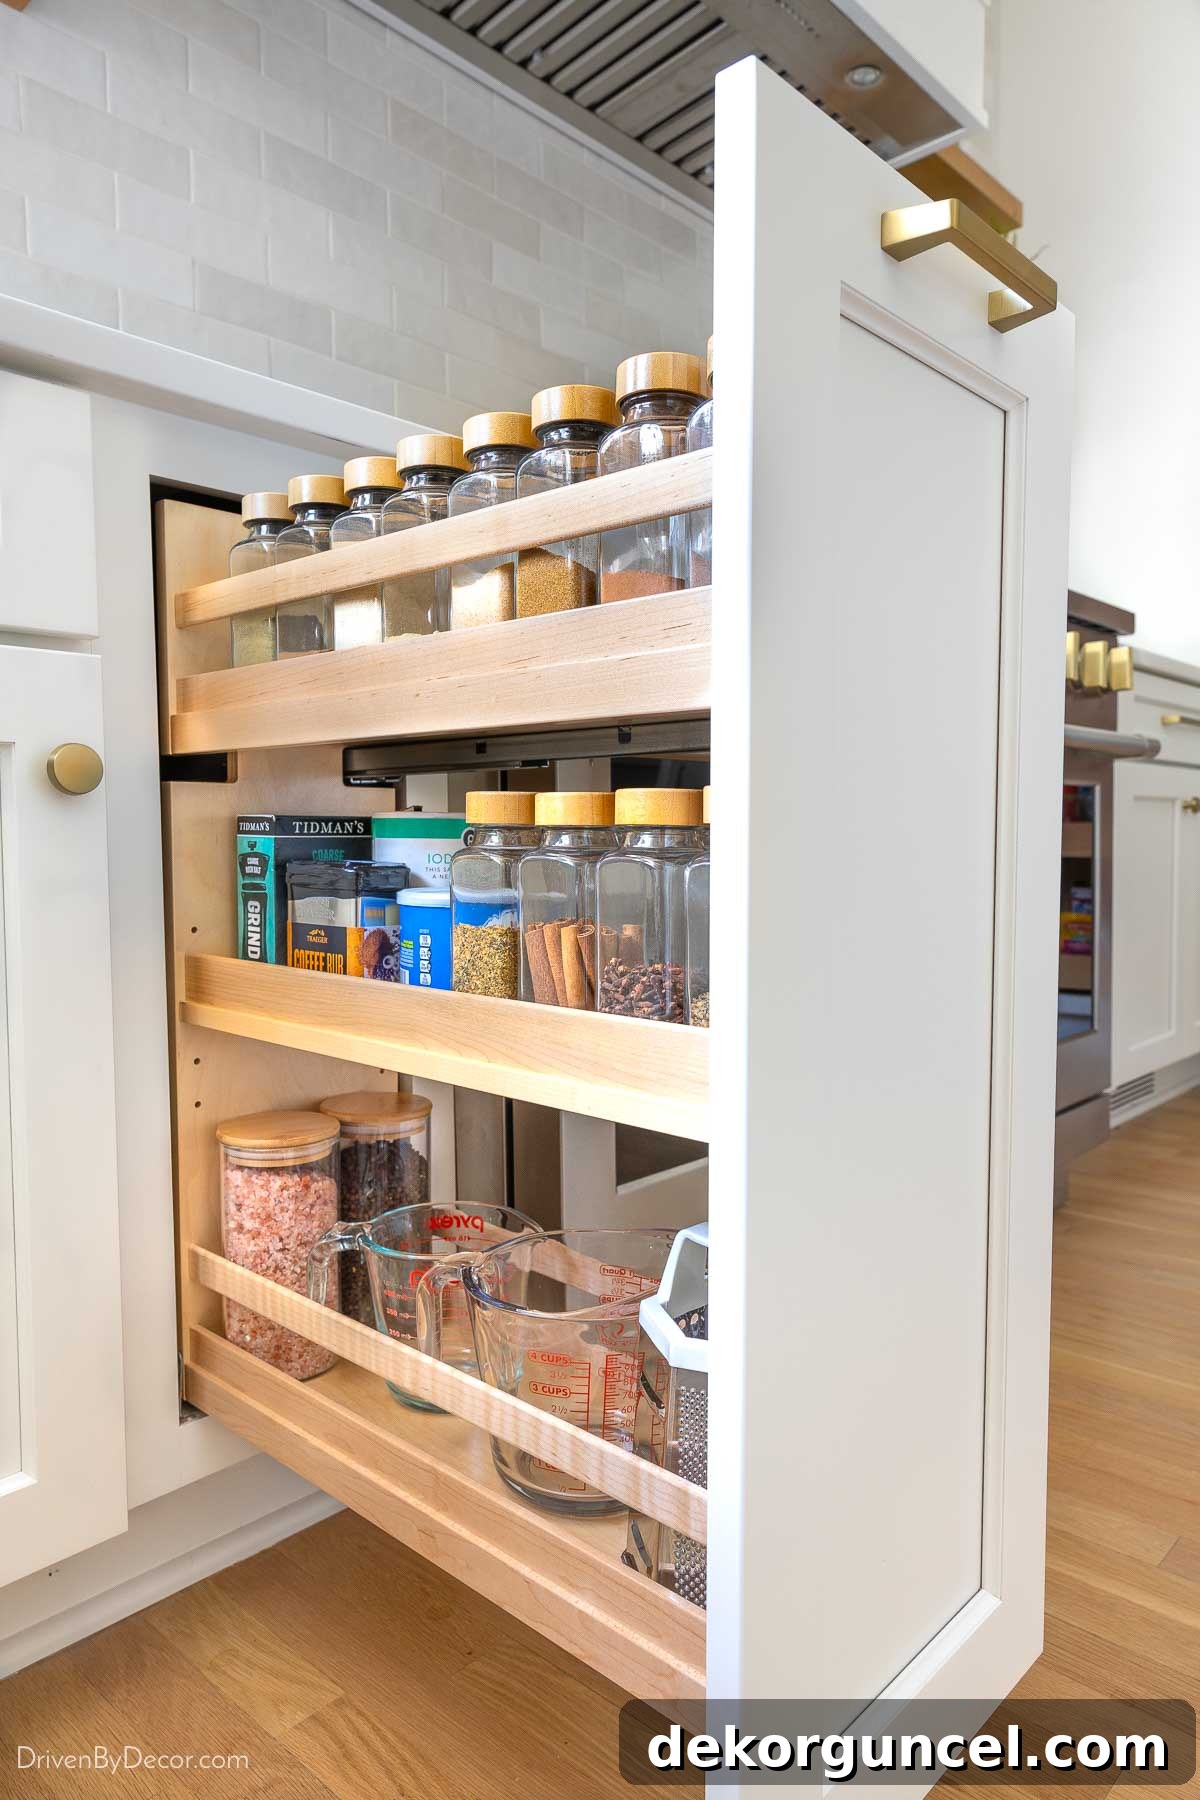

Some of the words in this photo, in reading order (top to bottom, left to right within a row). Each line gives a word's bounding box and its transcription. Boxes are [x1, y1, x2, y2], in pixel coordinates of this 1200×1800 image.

[239, 821, 270, 832] TIDMAN'S
[292, 820, 365, 834] TIDMAN'S
[311, 847, 345, 861] COARSE
[247, 900, 261, 960] GRIND
[306, 934, 328, 944] TRAEGER
[293, 948, 326, 971] COFFEE
[530, 1352, 538, 1360] 4
[540, 1353, 569, 1365] CUPS
[532, 1383, 539, 1391] 3
[541, 1385, 569, 1397] CUPS
